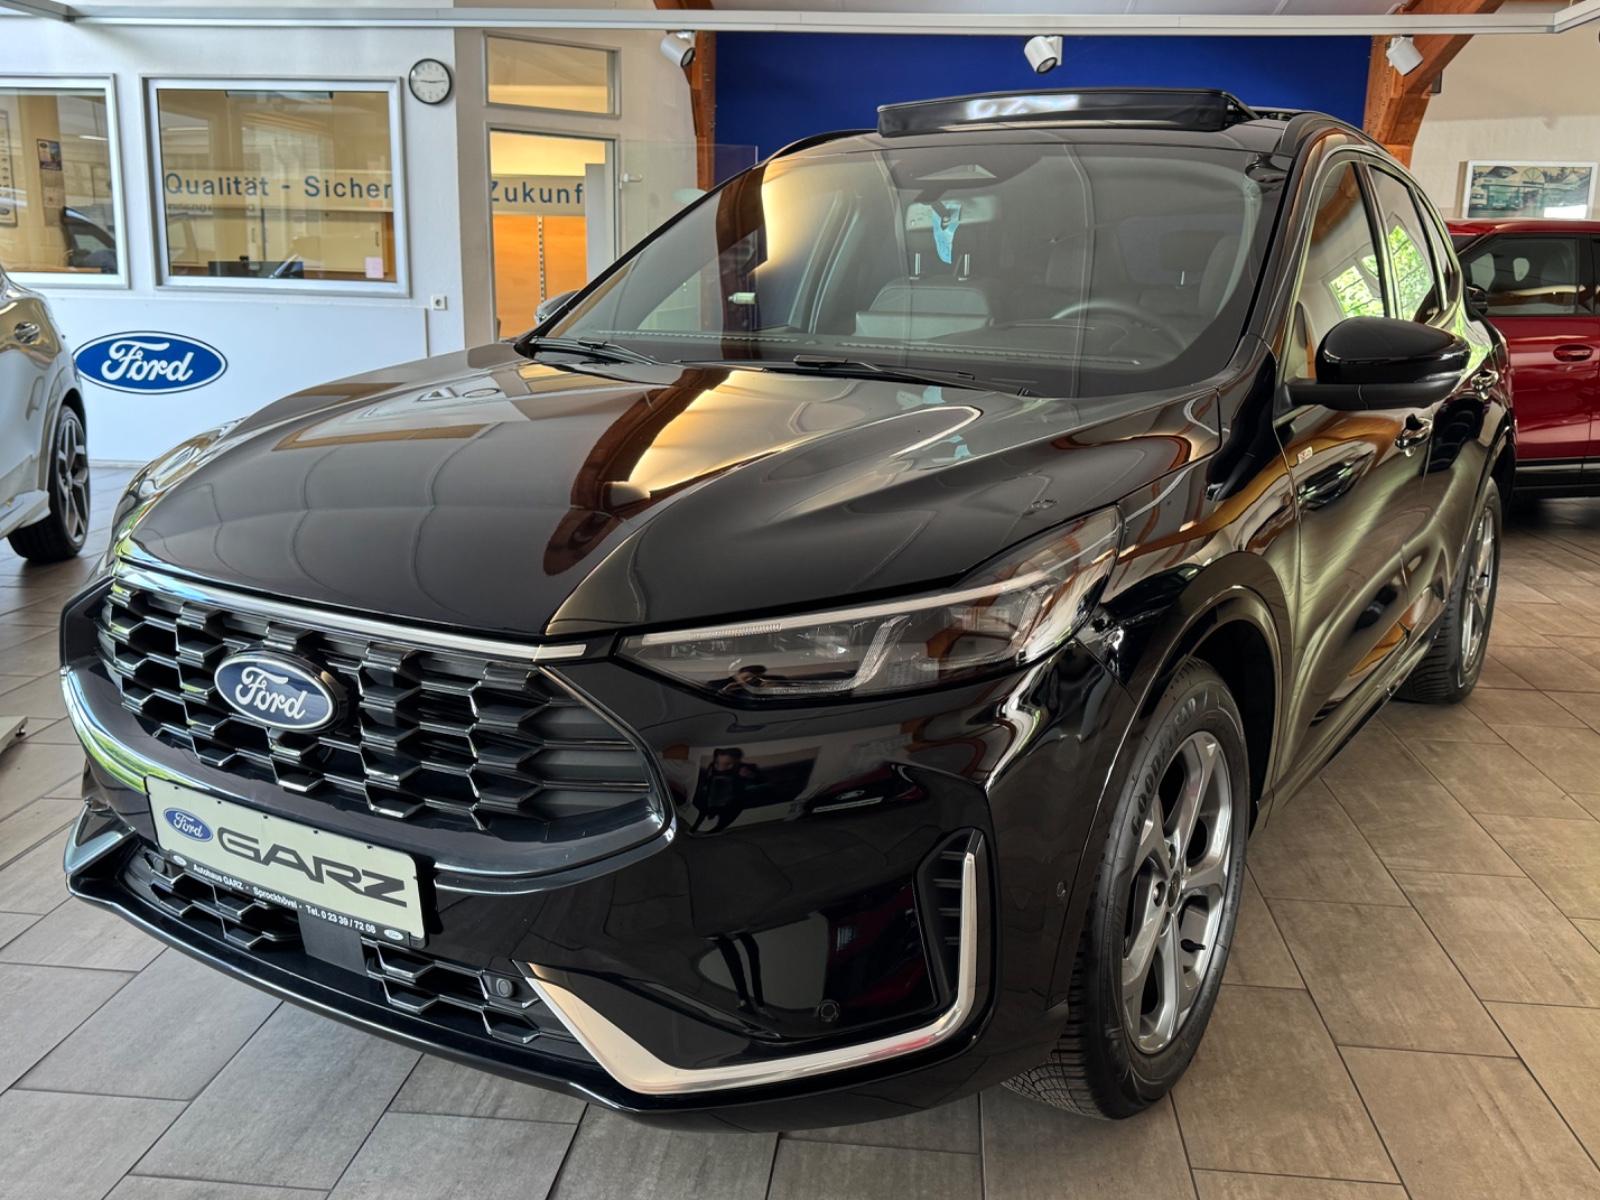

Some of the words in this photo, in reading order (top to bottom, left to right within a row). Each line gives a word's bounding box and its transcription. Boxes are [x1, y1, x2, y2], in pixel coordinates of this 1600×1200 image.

[165, 172, 269, 196] Qualität
[304, 175, 392, 199] Sicher
[491, 181, 583, 204] Zukunf
[101, 340, 195, 382] Ford
[235, 666, 308, 719] Ford
[172, 811, 205, 839] Ford
[217, 826, 408, 908] GARZ
[223, 875, 244, 890] GARZ
[305, 904, 320, 917] Tel.
